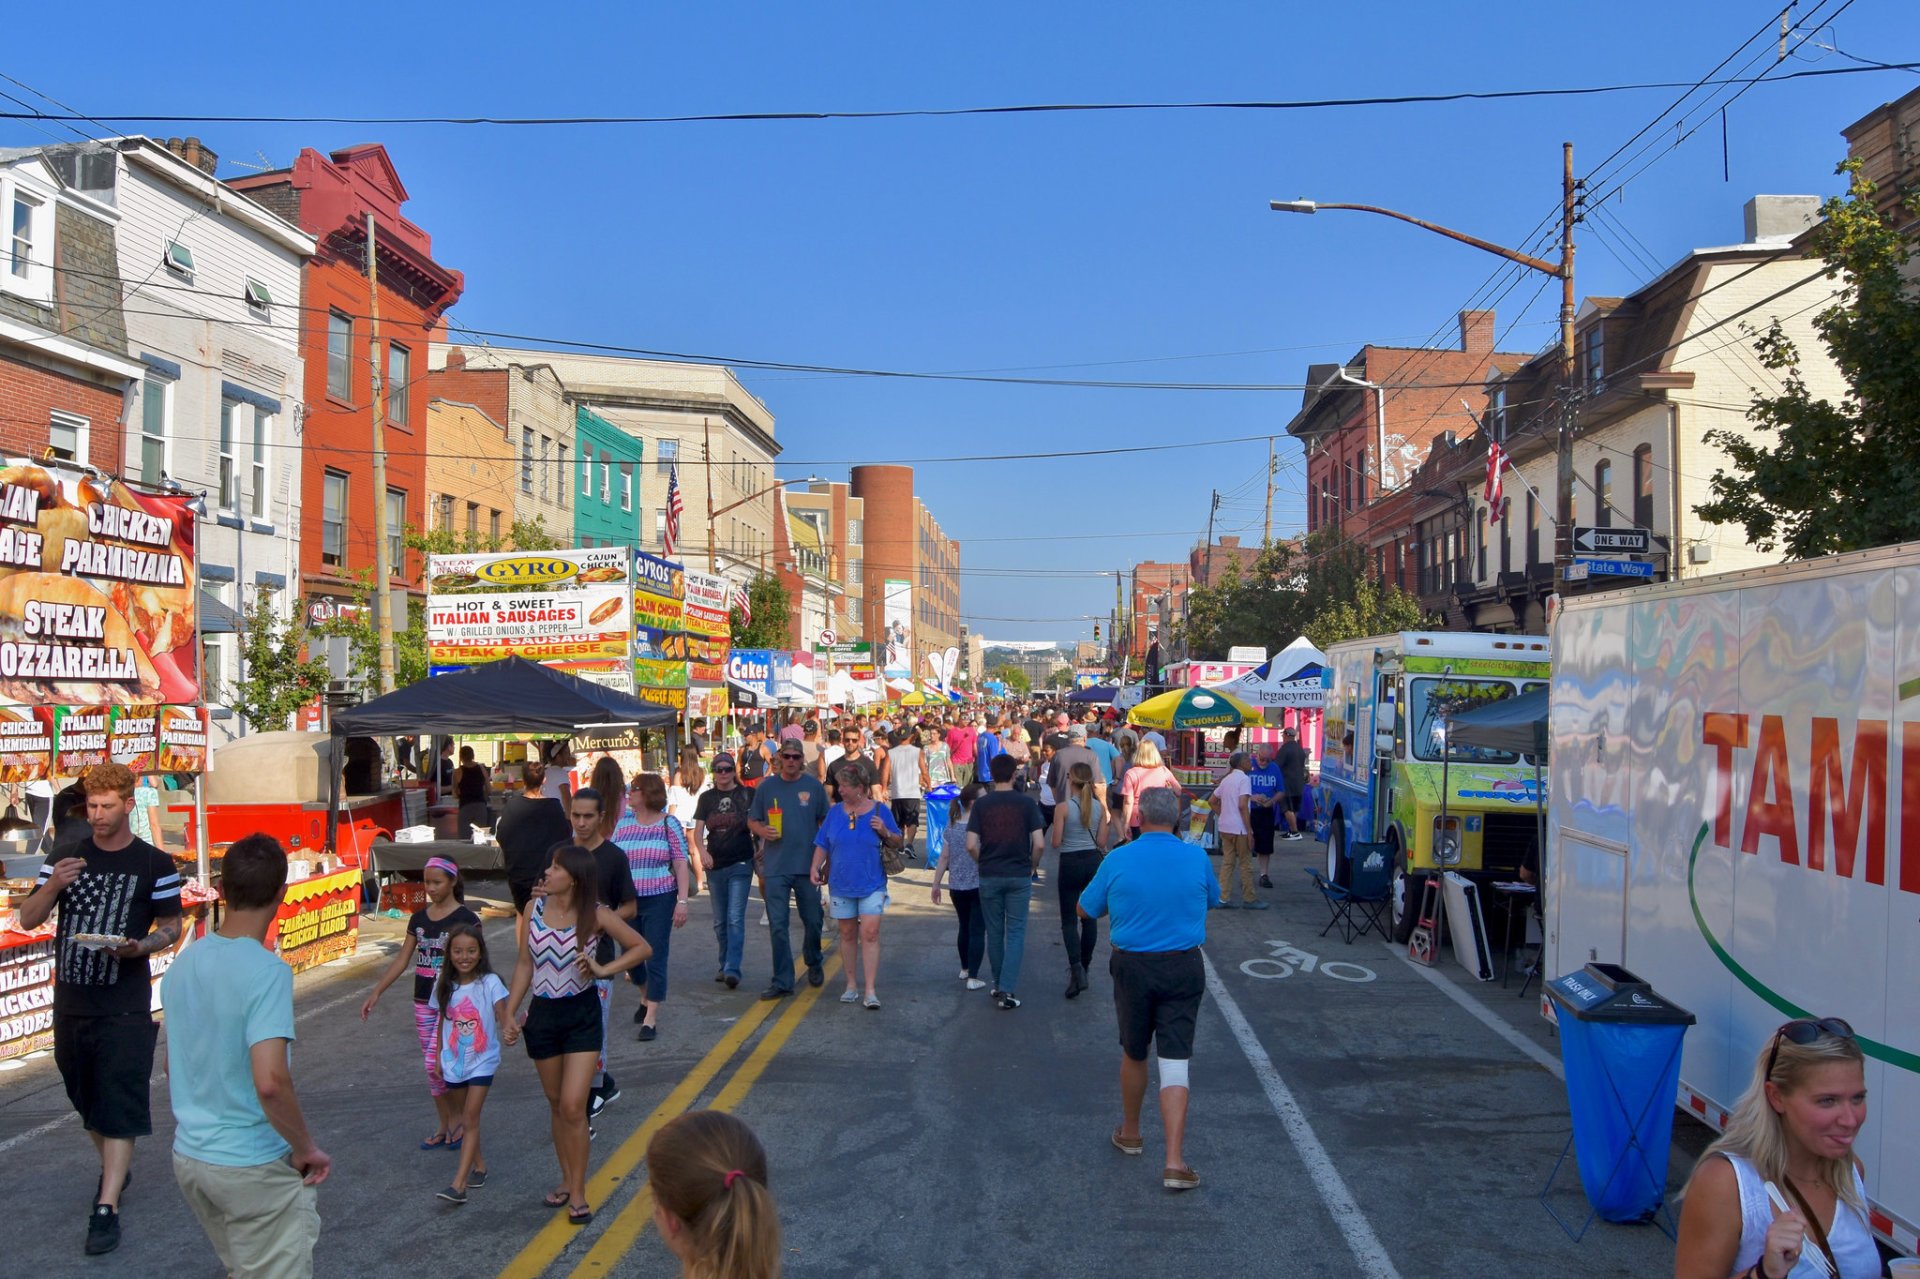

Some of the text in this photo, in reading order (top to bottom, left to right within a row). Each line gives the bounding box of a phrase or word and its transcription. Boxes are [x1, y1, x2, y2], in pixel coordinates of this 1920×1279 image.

[0, 484, 39, 524] IAN
[88, 501, 172, 546] CHICKEN
[1594, 535, 1641, 546] ONE WAY
[61, 537, 184, 585] PARMIGIANA
[580, 561, 624, 570] CHICKEN
[587, 554, 617, 562] CAJUN
[485, 561, 570, 577] GYRO
[636, 557, 669, 583] GYROS
[1586, 561, 1615, 573] State
[1621, 563, 1645, 576] Way
[457, 598, 554, 612] HOT & SWEET
[24, 599, 105, 638] STEAK
[433, 608, 576, 625] ITALIAN SAUSAGES
[461, 627, 493, 637] GRILLED
[539, 624, 568, 634] PEPPER
[510, 633, 600, 646] SAUSAGE
[435, 644, 601, 658] STEAK & CHEESE
[0, 642, 138, 679] OZZARELLA
[730, 656, 768, 679] Cakes
[0, 721, 43, 735] CHICKEN
[61, 716, 104, 732] ITALIAN
[114, 718, 156, 735] BUCKET
[169, 718, 203, 732] CHICKEN
[1183, 715, 1233, 726] LEMONADE
[58, 734, 107, 752] SAUSAGE
[111, 737, 157, 755] OF FRIES
[575, 733, 640, 751] Mercurio's
[63, 754, 103, 768] With Fries
[282, 924, 319, 950] CHICKEN
[1562, 977, 1598, 1001] TRASH ONLY
